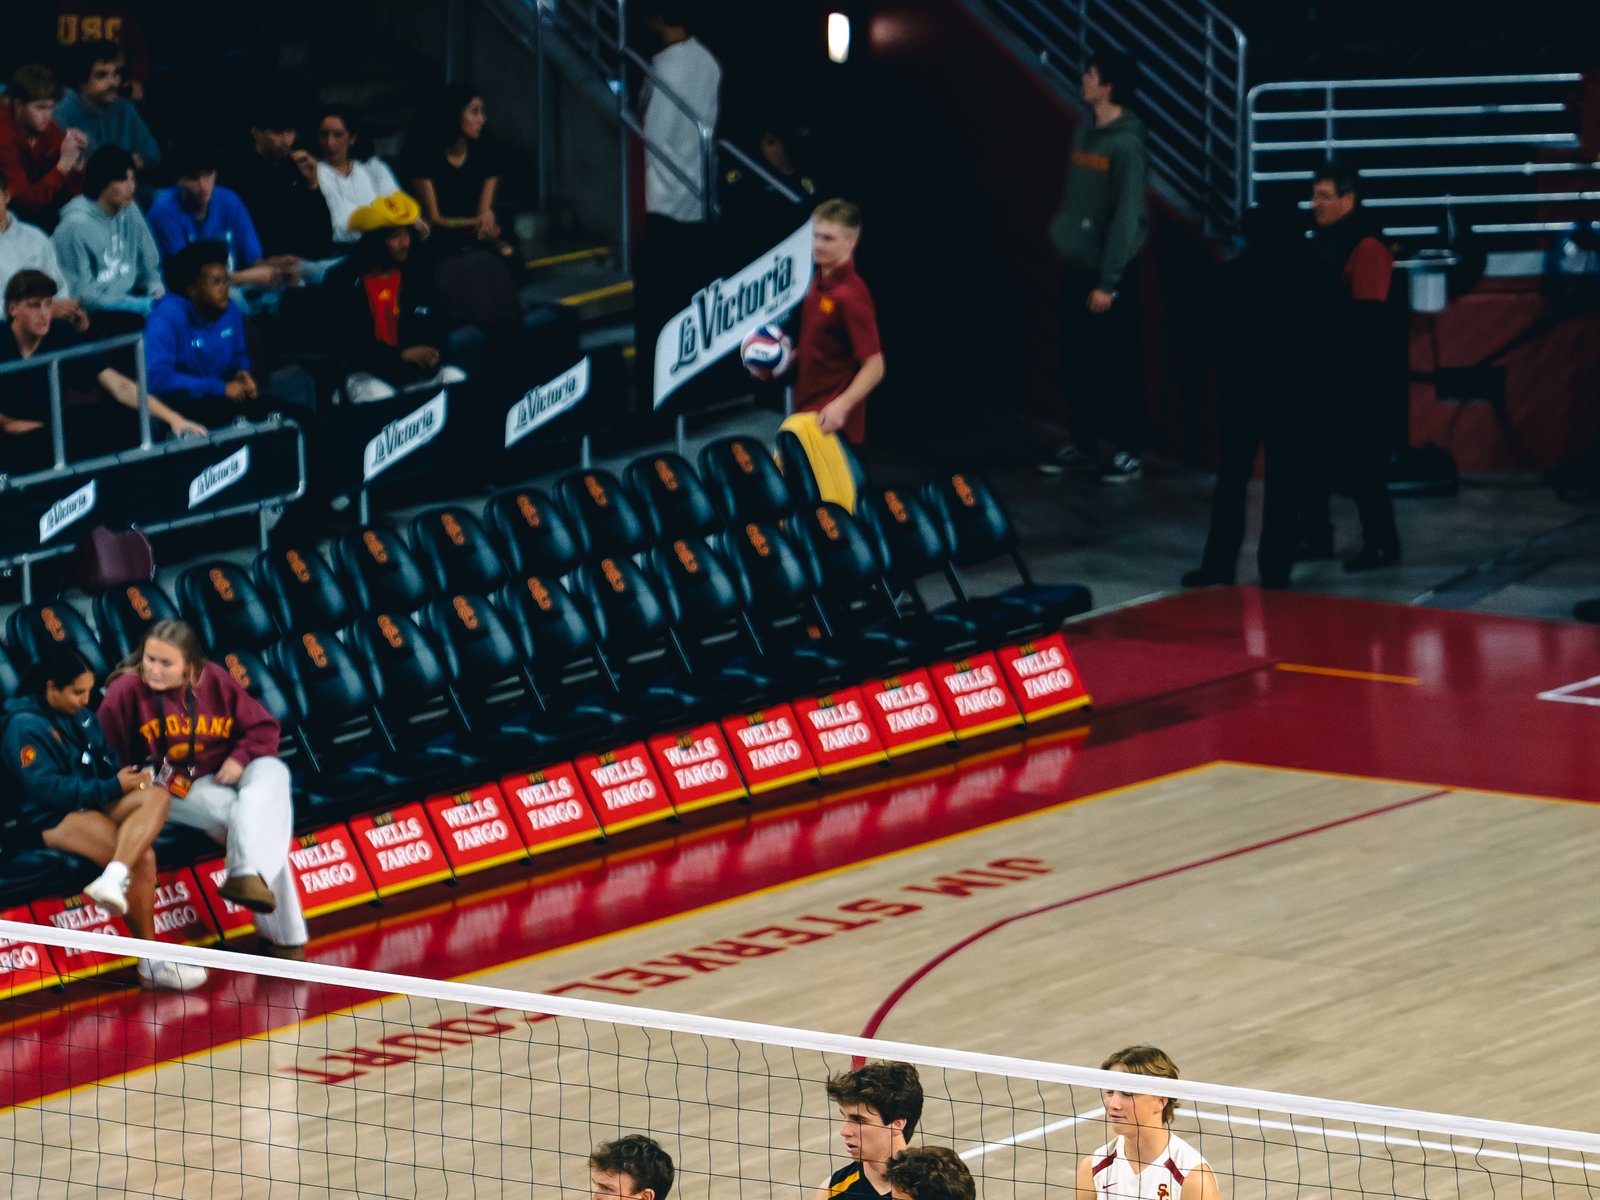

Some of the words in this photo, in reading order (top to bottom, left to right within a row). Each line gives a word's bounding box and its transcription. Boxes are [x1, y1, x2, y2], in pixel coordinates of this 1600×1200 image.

[670, 314, 698, 375] La
[691, 254, 793, 351] Victoria
[524, 373, 576, 420] Victoria
[381, 407, 433, 455] Victoria
[1012, 647, 1065, 677] WELLS
[944, 665, 997, 695] WELLS
[1022, 668, 1074, 700] FARGO
[875, 682, 930, 712] WELLS
[954, 687, 1006, 717] FARGO
[808, 700, 863, 730] WELLS
[885, 703, 939, 734] FARGO
[737, 717, 793, 748] WELLS
[818, 722, 871, 753] FARGO
[663, 737, 720, 768] WELLS
[747, 739, 801, 771] FARGO
[591, 756, 647, 788] WELLS
[674, 759, 729, 790] FARGO
[515, 776, 575, 808] WELLS
[601, 778, 657, 810] FARGO
[440, 797, 500, 829] WELLS
[527, 799, 584, 830] FARGO
[365, 816, 424, 849] WELLS
[452, 819, 509, 851] FARGO
[288, 838, 347, 871] WELLS
[376, 839, 433, 872] FARGO
[300, 861, 358, 894] FARGO
[153, 905, 197, 935] ARGO
